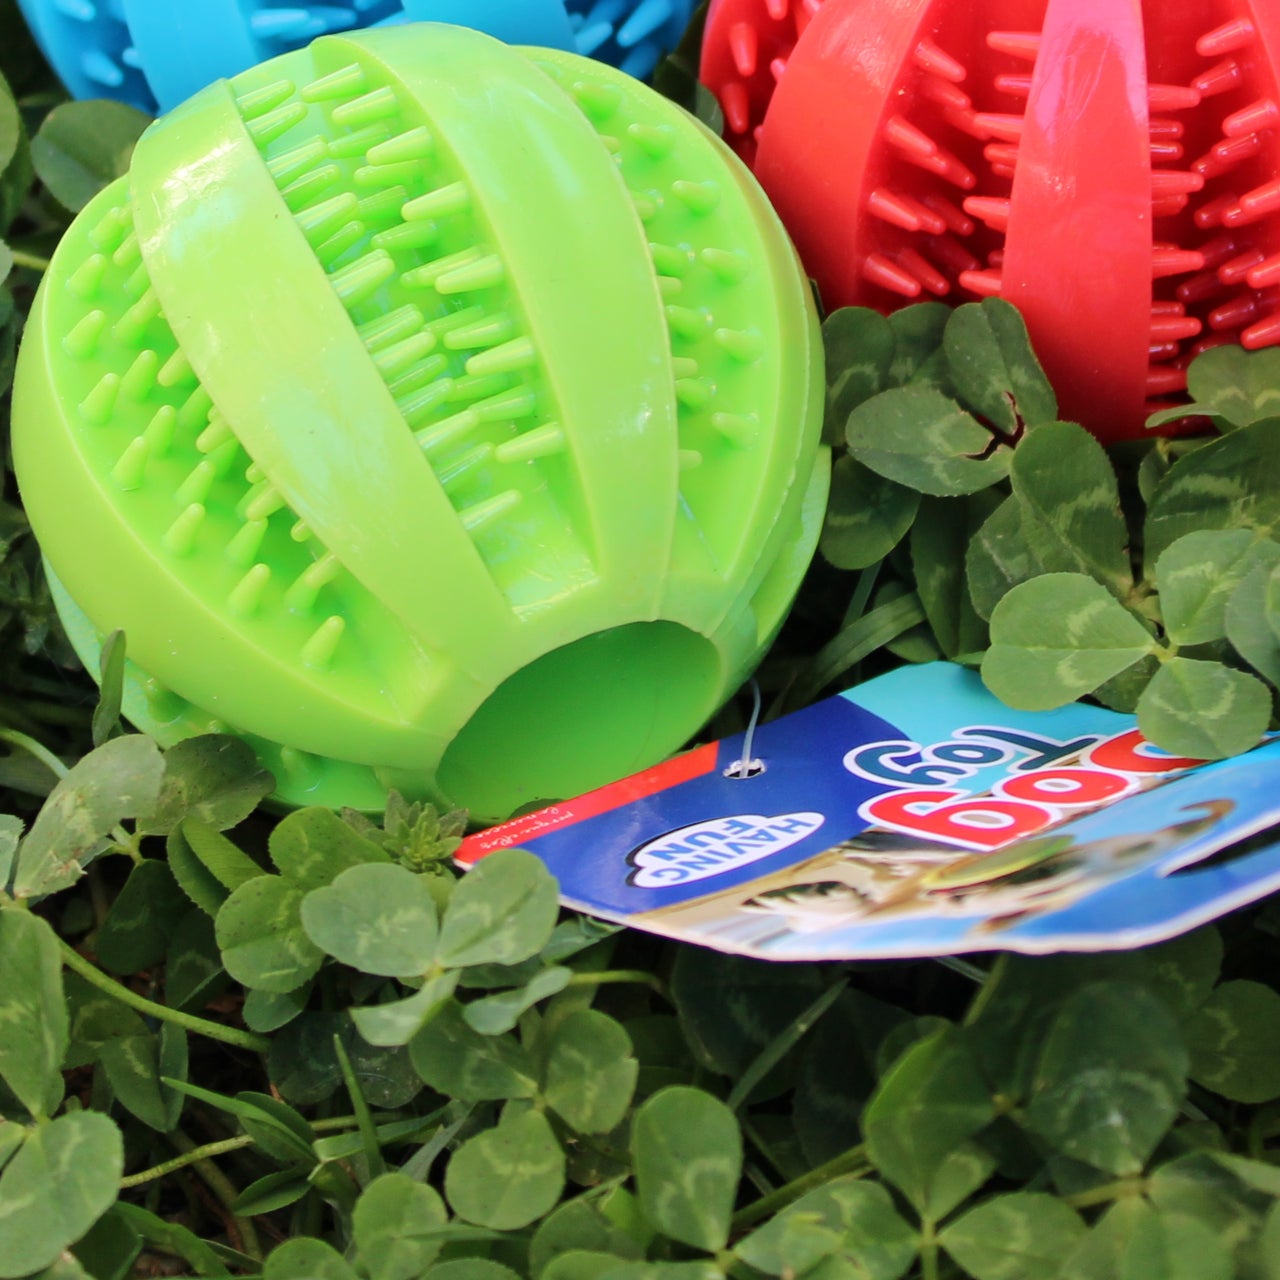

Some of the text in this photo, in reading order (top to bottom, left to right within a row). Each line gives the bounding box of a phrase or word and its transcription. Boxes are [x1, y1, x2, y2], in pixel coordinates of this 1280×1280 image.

[852, 726, 1100, 787] Toy
[645, 819, 756, 863] FUN
[651, 817, 813, 882] HAVING
